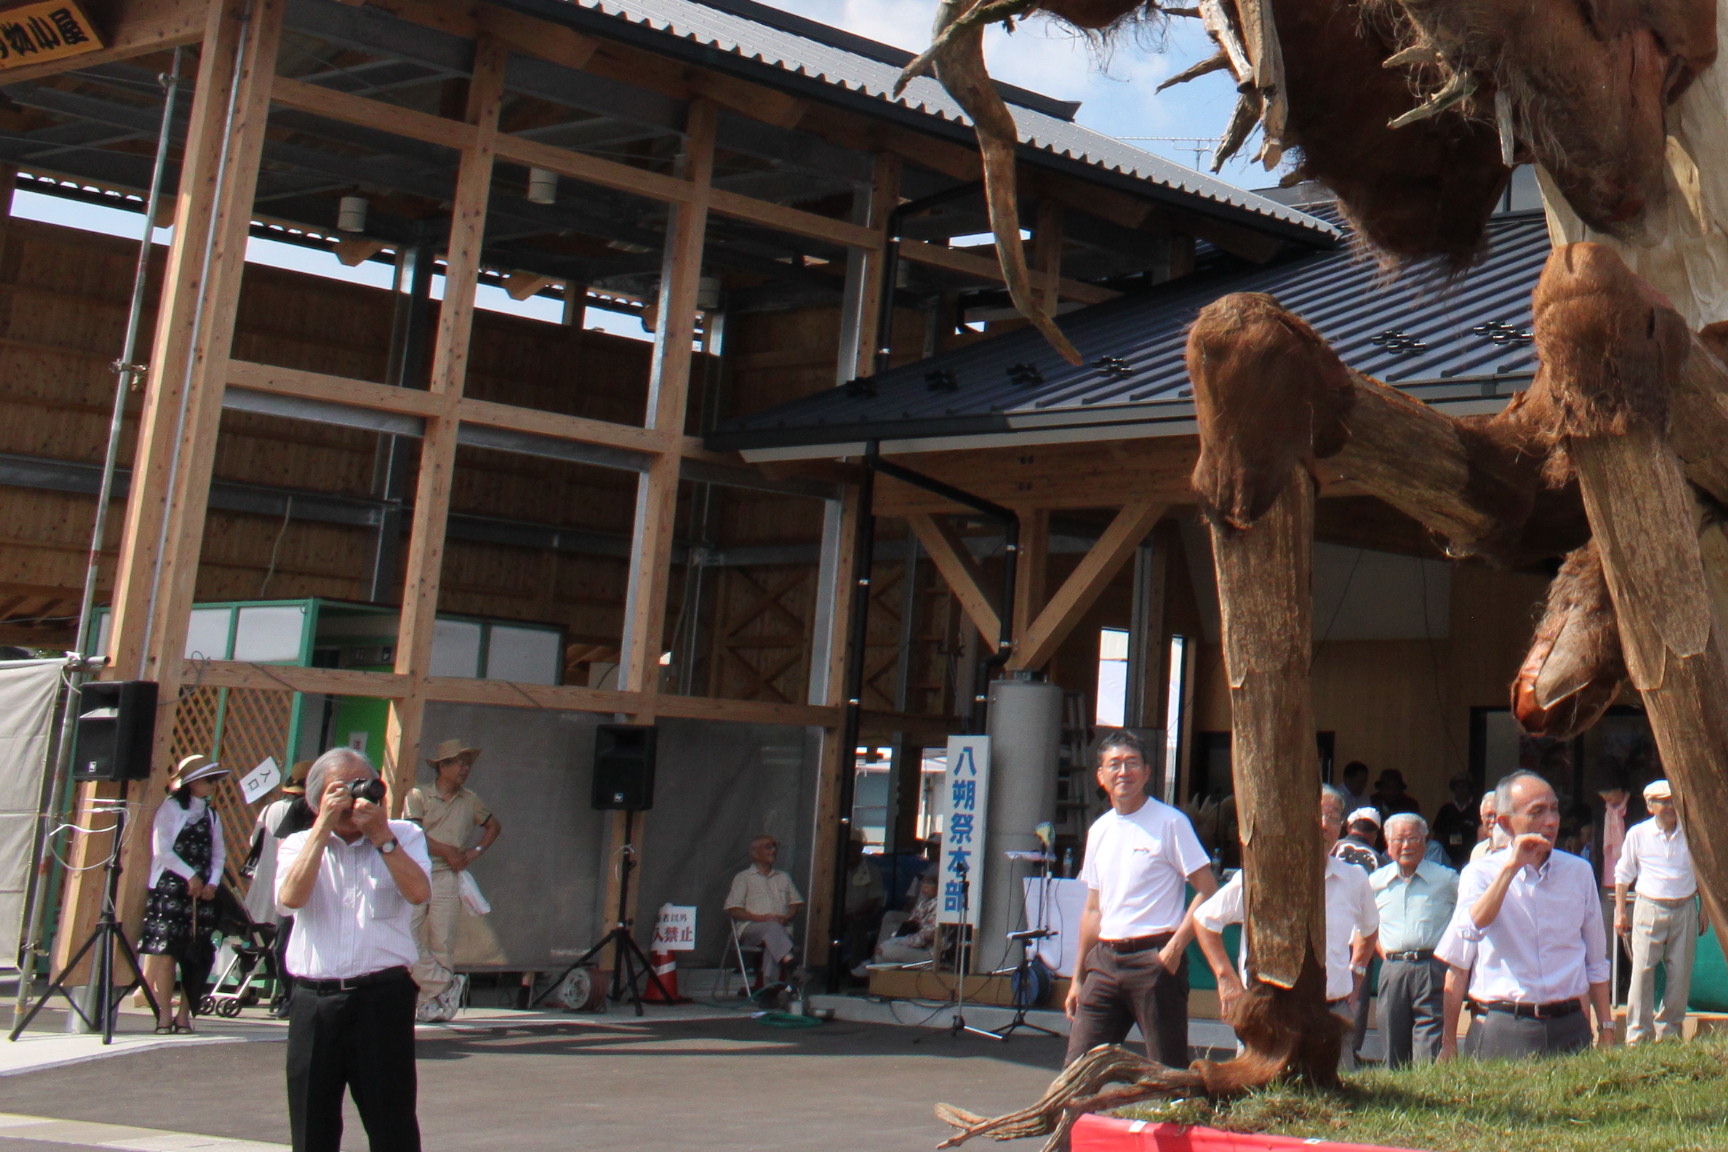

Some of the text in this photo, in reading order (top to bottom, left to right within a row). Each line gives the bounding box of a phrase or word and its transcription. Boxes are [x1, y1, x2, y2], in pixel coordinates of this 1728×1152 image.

[248, 769, 271, 791] 入口
[944, 746, 978, 912] 八朔祭本部
